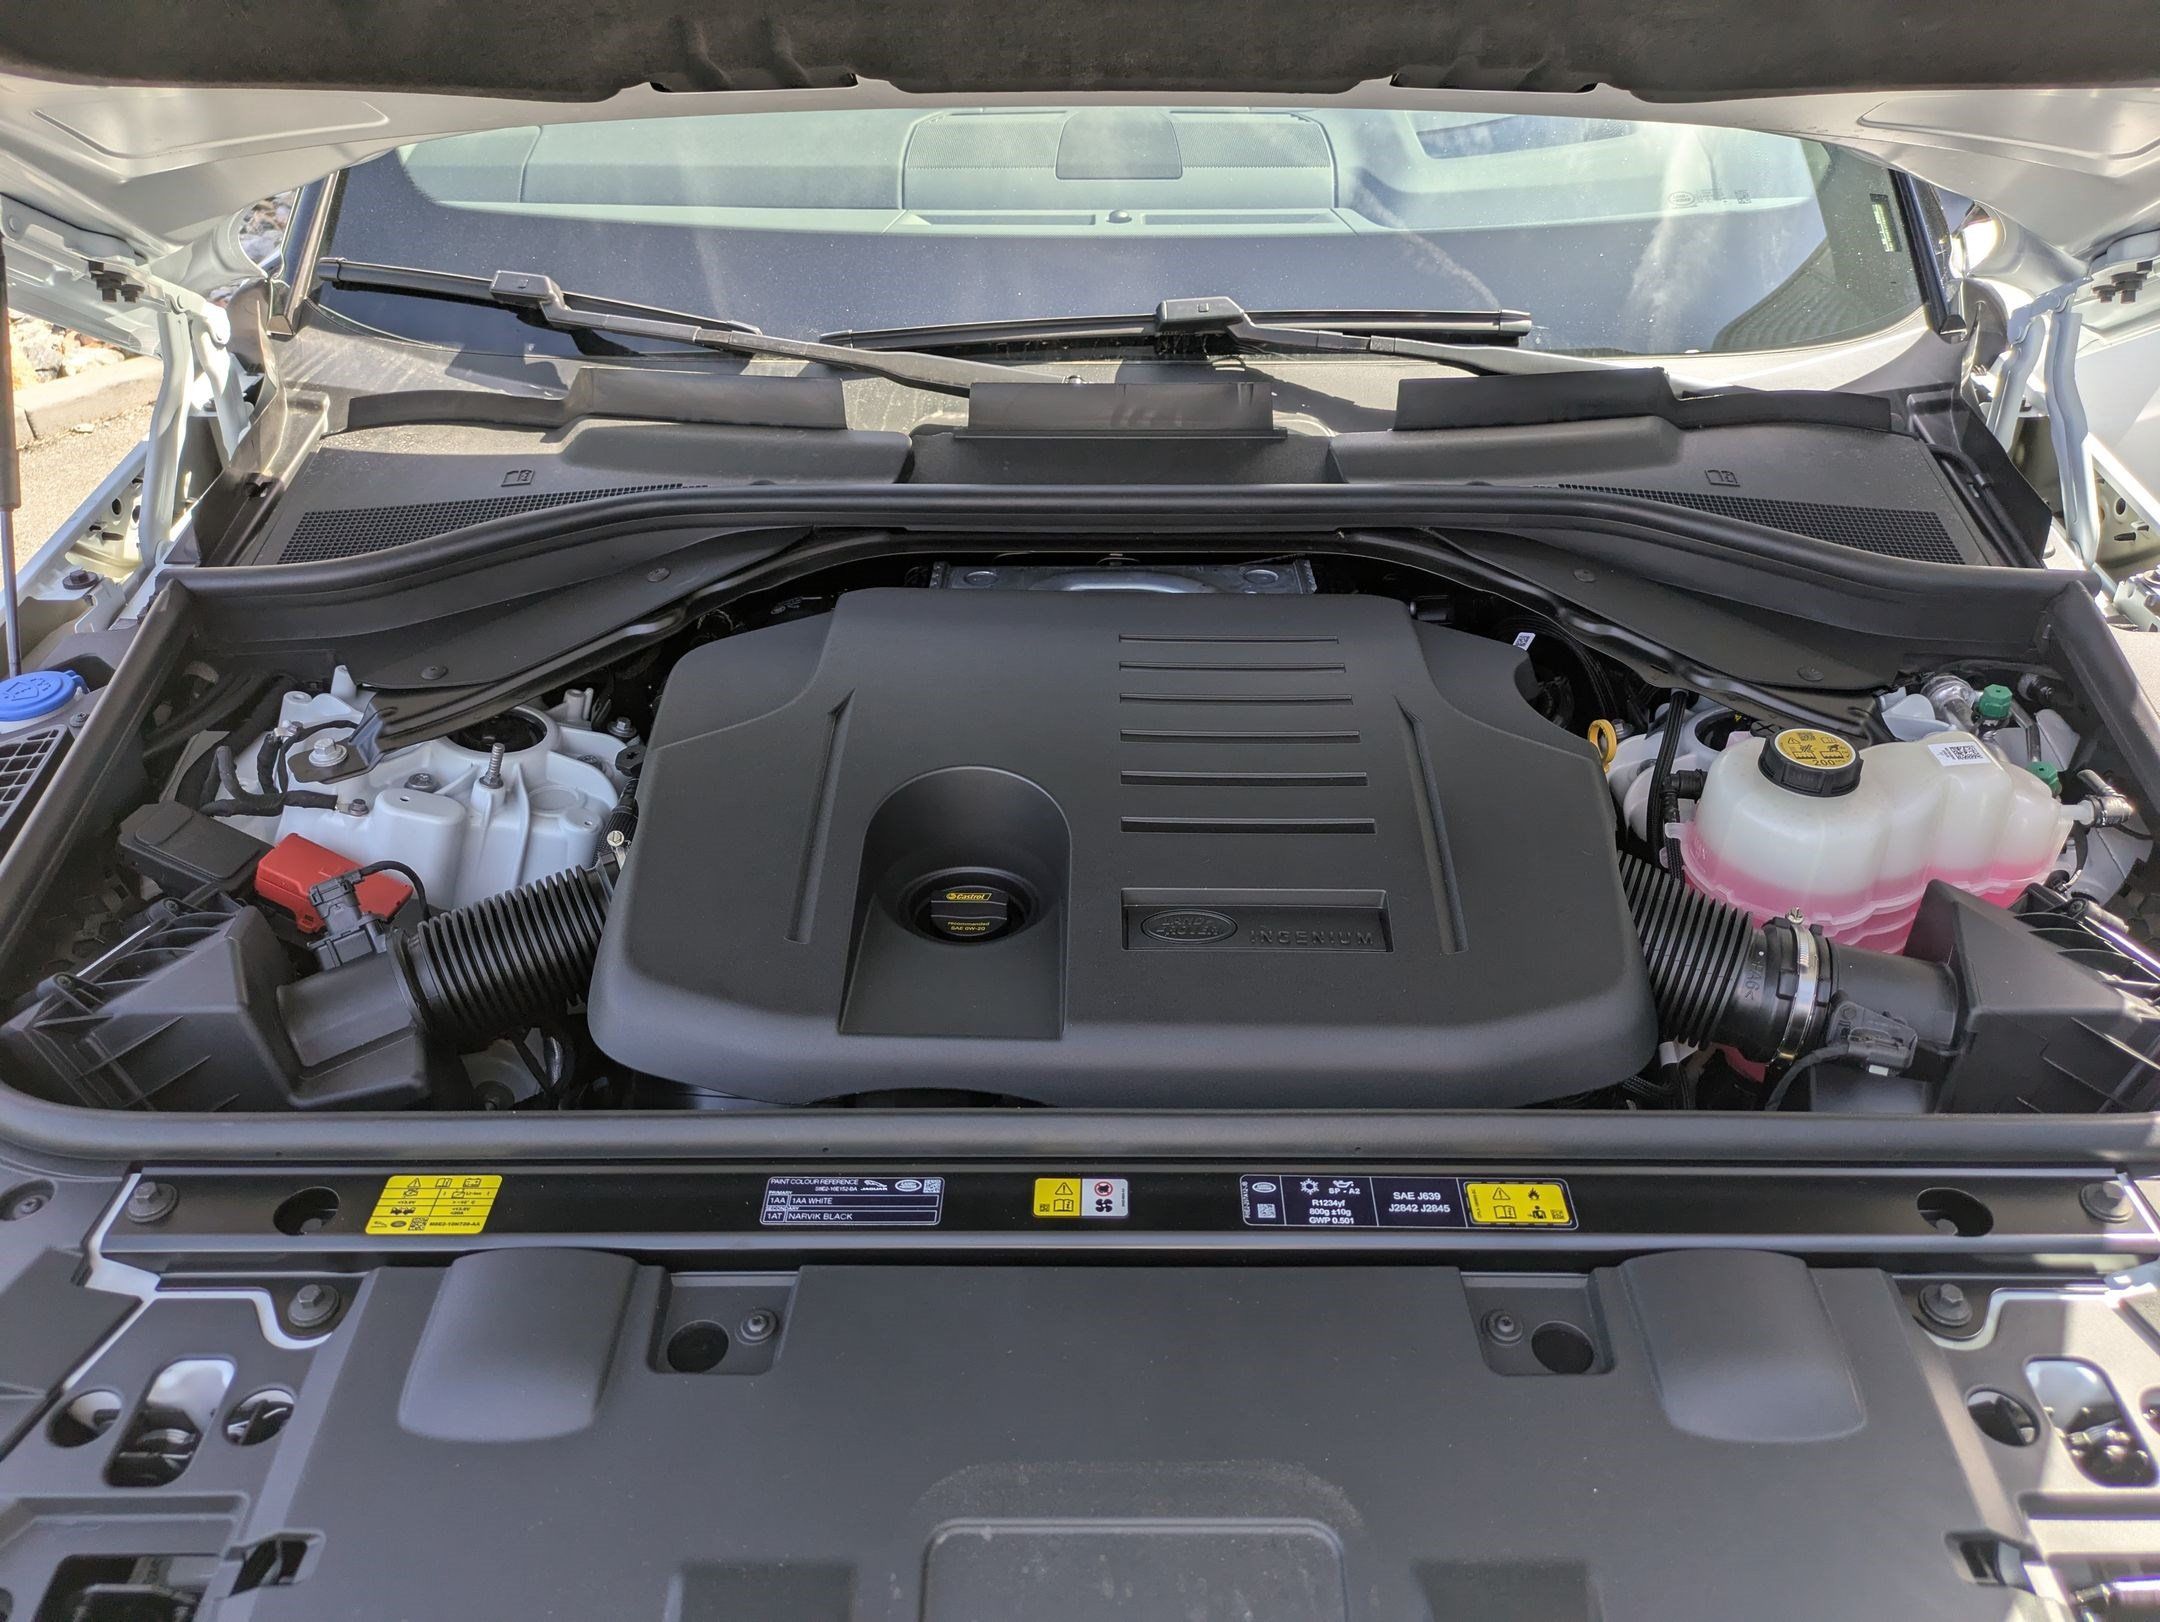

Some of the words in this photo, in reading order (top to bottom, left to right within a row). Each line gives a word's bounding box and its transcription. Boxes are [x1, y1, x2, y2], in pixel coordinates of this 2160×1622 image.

[1250, 929, 1374, 945] INGENIUM
[1329, 1187, 1341, 1195] SP
[1393, 1191, 1416, 1200] SAE
[1418, 1192, 1441, 1201] J639
[808, 1197, 833, 1205] WHITE
[1312, 1199, 1346, 1208] R1234yf
[1389, 1204, 1419, 1213] J2842
[1421, 1204, 1451, 1213] J2845
[823, 1213, 853, 1221] BLACK
[1309, 1216, 1331, 1224] GWP
[1332, 1217, 1355, 1225] 0.501
